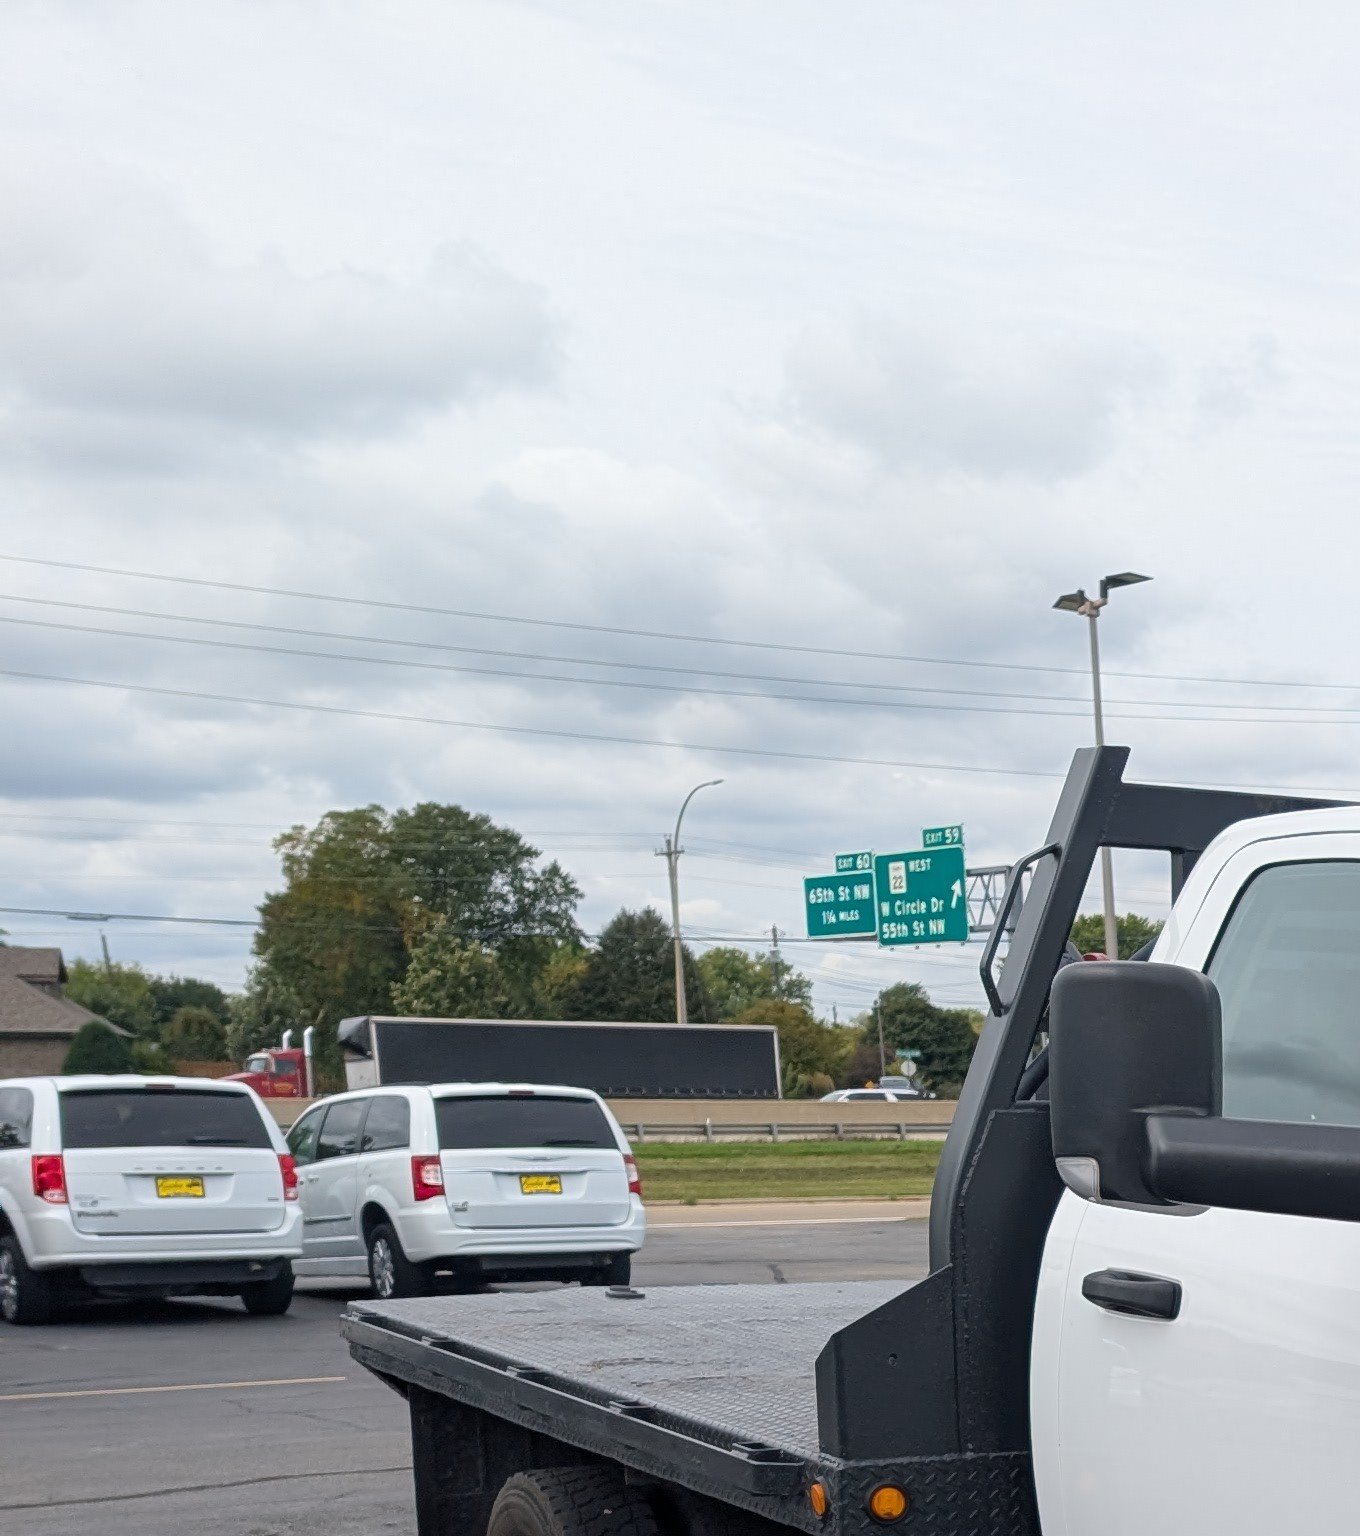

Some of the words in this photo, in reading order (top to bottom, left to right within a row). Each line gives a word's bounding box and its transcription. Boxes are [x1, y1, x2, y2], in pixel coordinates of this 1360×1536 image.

[925, 831, 943, 845] EXIT
[944, 827, 960, 844] 59
[837, 857, 853, 869] EXIT
[856, 853, 871, 869] 60
[908, 857, 932, 873] WEST
[891, 874, 904, 890] 22
[809, 887, 835, 904] 65th
[838, 885, 851, 902] St
[853, 883, 870, 900] NW
[880, 901, 890, 917] W
[894, 898, 927, 916] Circle
[930, 896, 944, 913] Dr
[839, 909, 860, 922] MILES
[882, 921, 909, 939] 55th
[912, 920, 925, 937] St
[928, 918, 945, 936] NW
